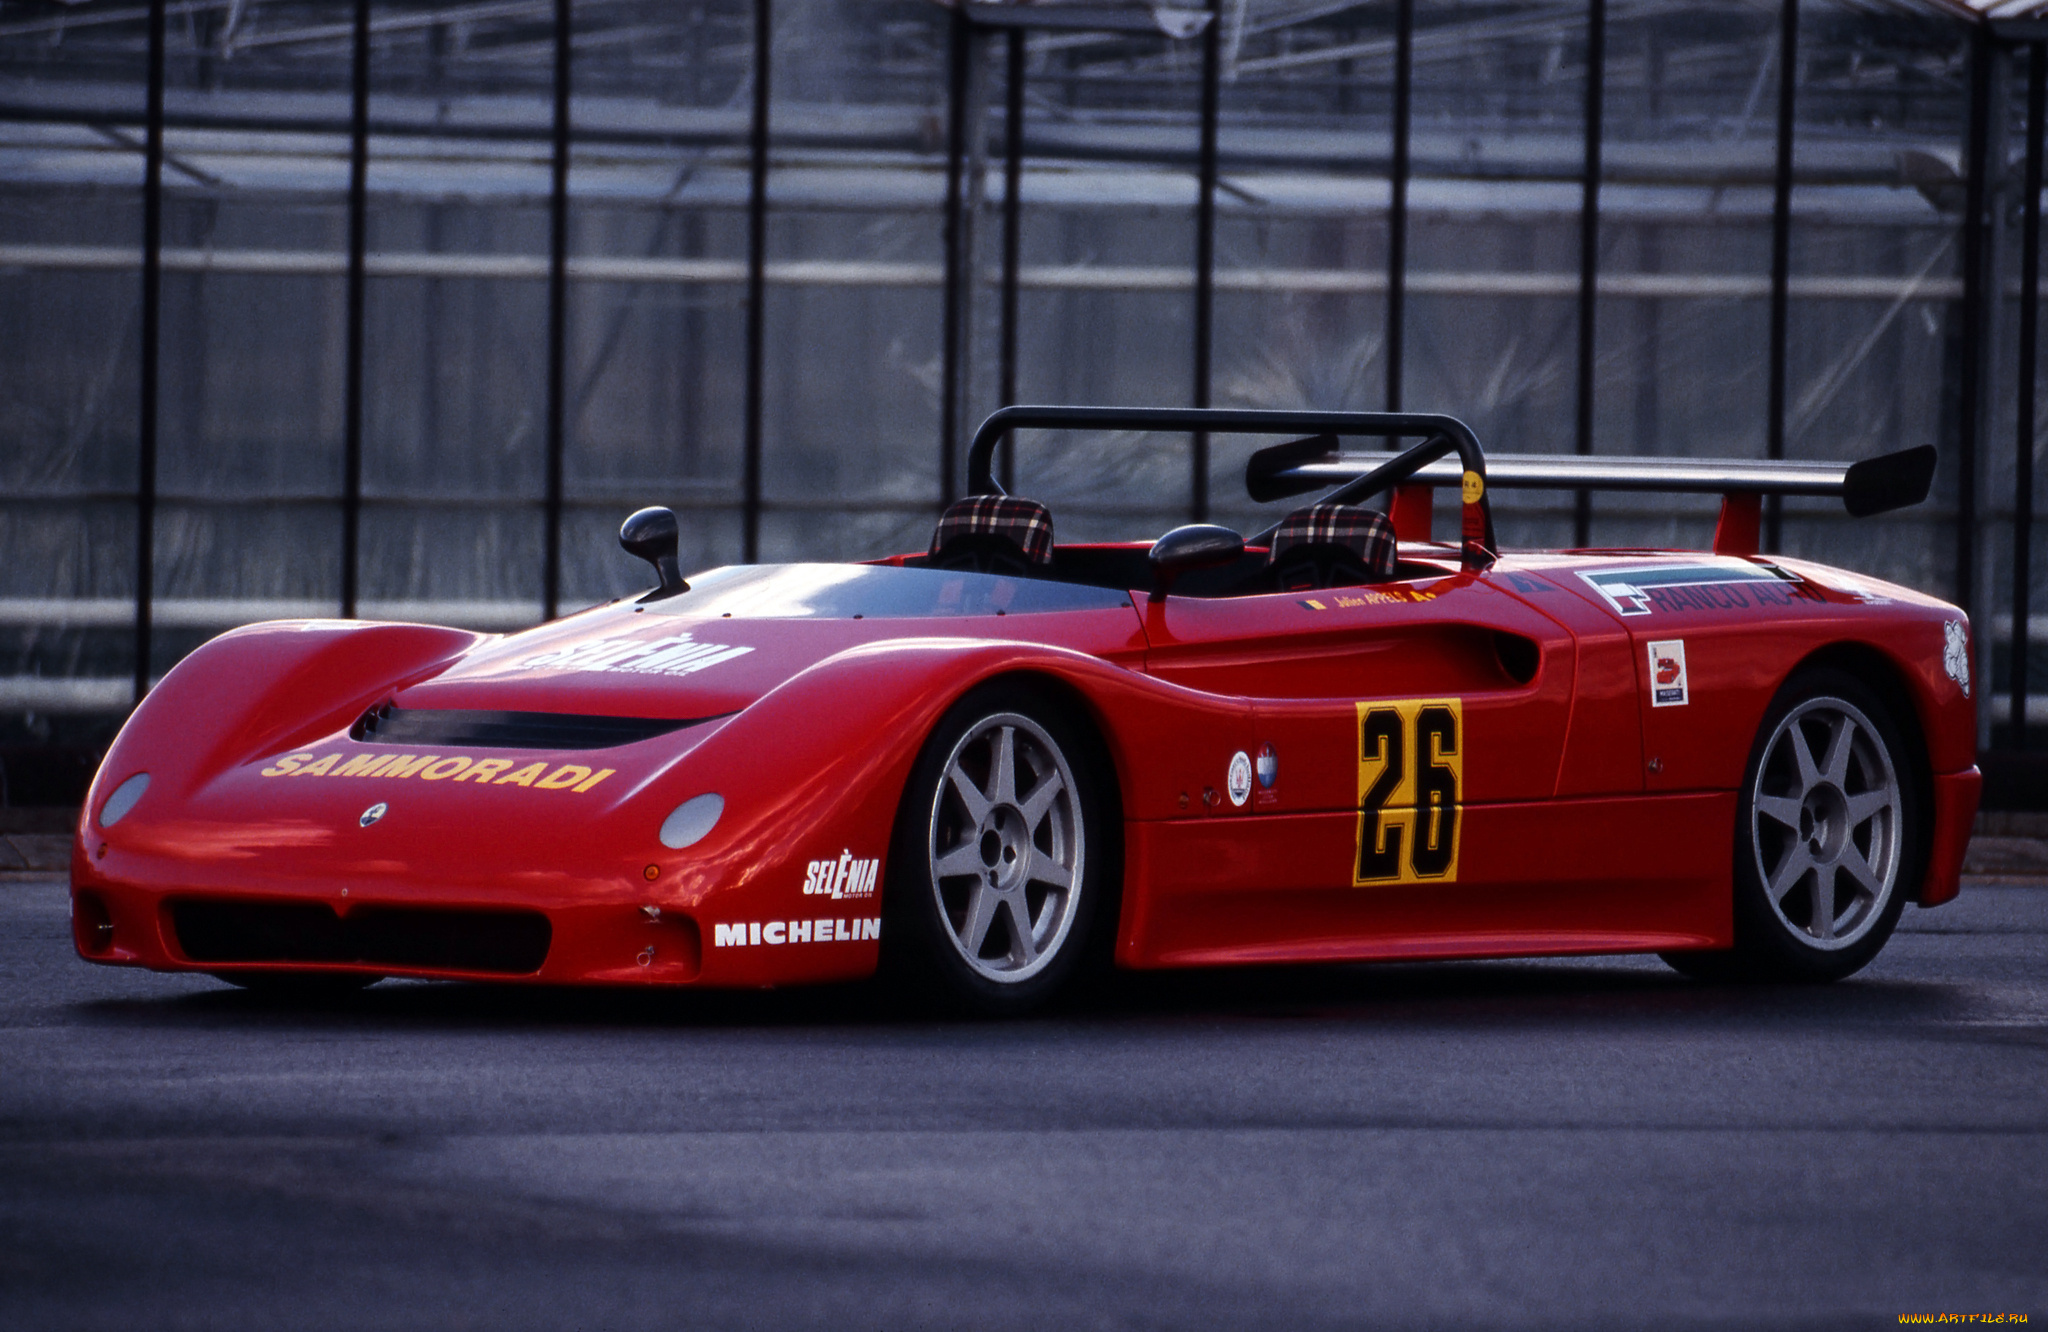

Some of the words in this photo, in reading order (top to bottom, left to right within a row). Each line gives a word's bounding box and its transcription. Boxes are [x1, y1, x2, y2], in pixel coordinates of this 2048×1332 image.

[1760, 581, 1828, 608] AUTO
[261, 753, 616, 793] SAMMORADI
[1357, 704, 1458, 882] 26
[715, 918, 881, 947] MICHELIN
